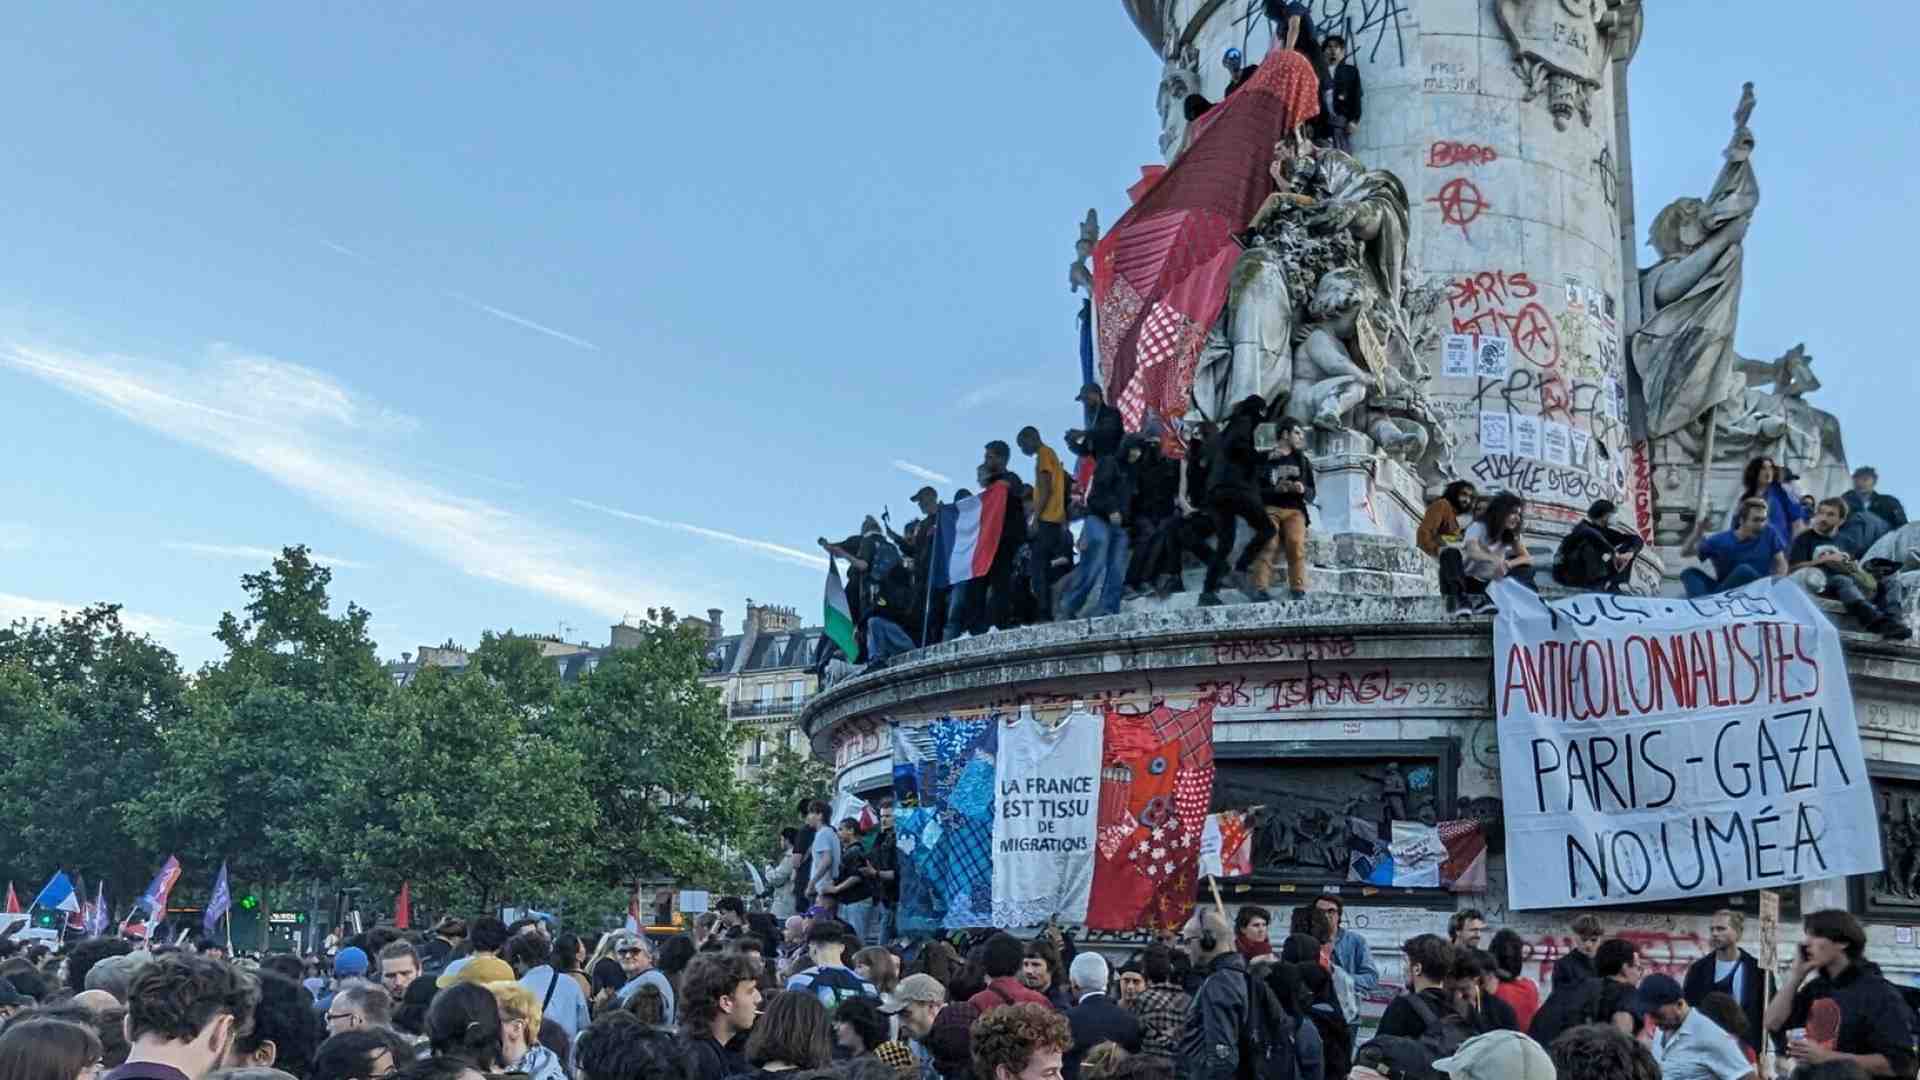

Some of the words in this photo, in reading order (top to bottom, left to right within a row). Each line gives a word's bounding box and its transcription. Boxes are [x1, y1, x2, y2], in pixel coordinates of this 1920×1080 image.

[1502, 621, 1819, 721] ANTICOLONIALISTES
[1001, 780, 1020, 796] LA
[1026, 777, 1093, 794] FRANCE
[1003, 800, 1034, 819] EST
[1039, 800, 1089, 819] TISSU
[1038, 820, 1055, 834] DE
[1000, 836, 1088, 853] MIGRATIONS
[1566, 801, 1827, 899] NOUMÉA
